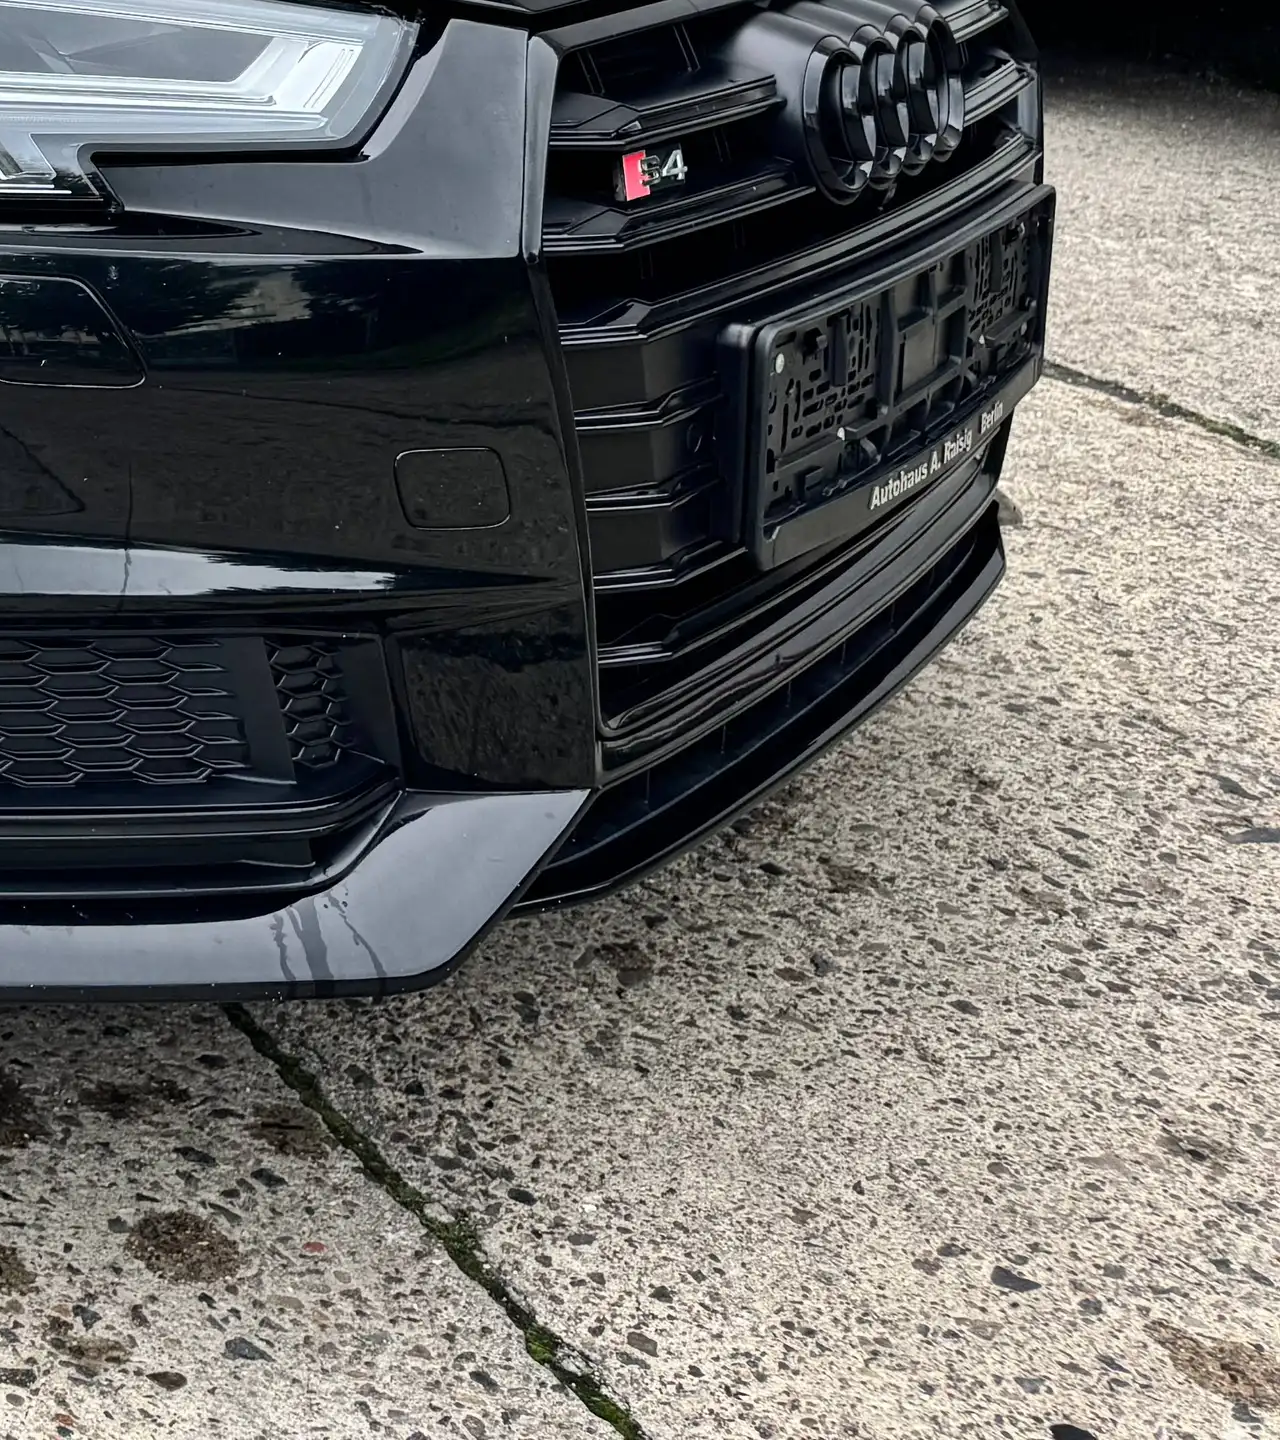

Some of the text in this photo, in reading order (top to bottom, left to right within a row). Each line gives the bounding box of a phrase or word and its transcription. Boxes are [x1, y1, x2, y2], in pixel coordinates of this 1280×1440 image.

[870, 401, 1004, 511] Autohaus A. Raisig Berlin
